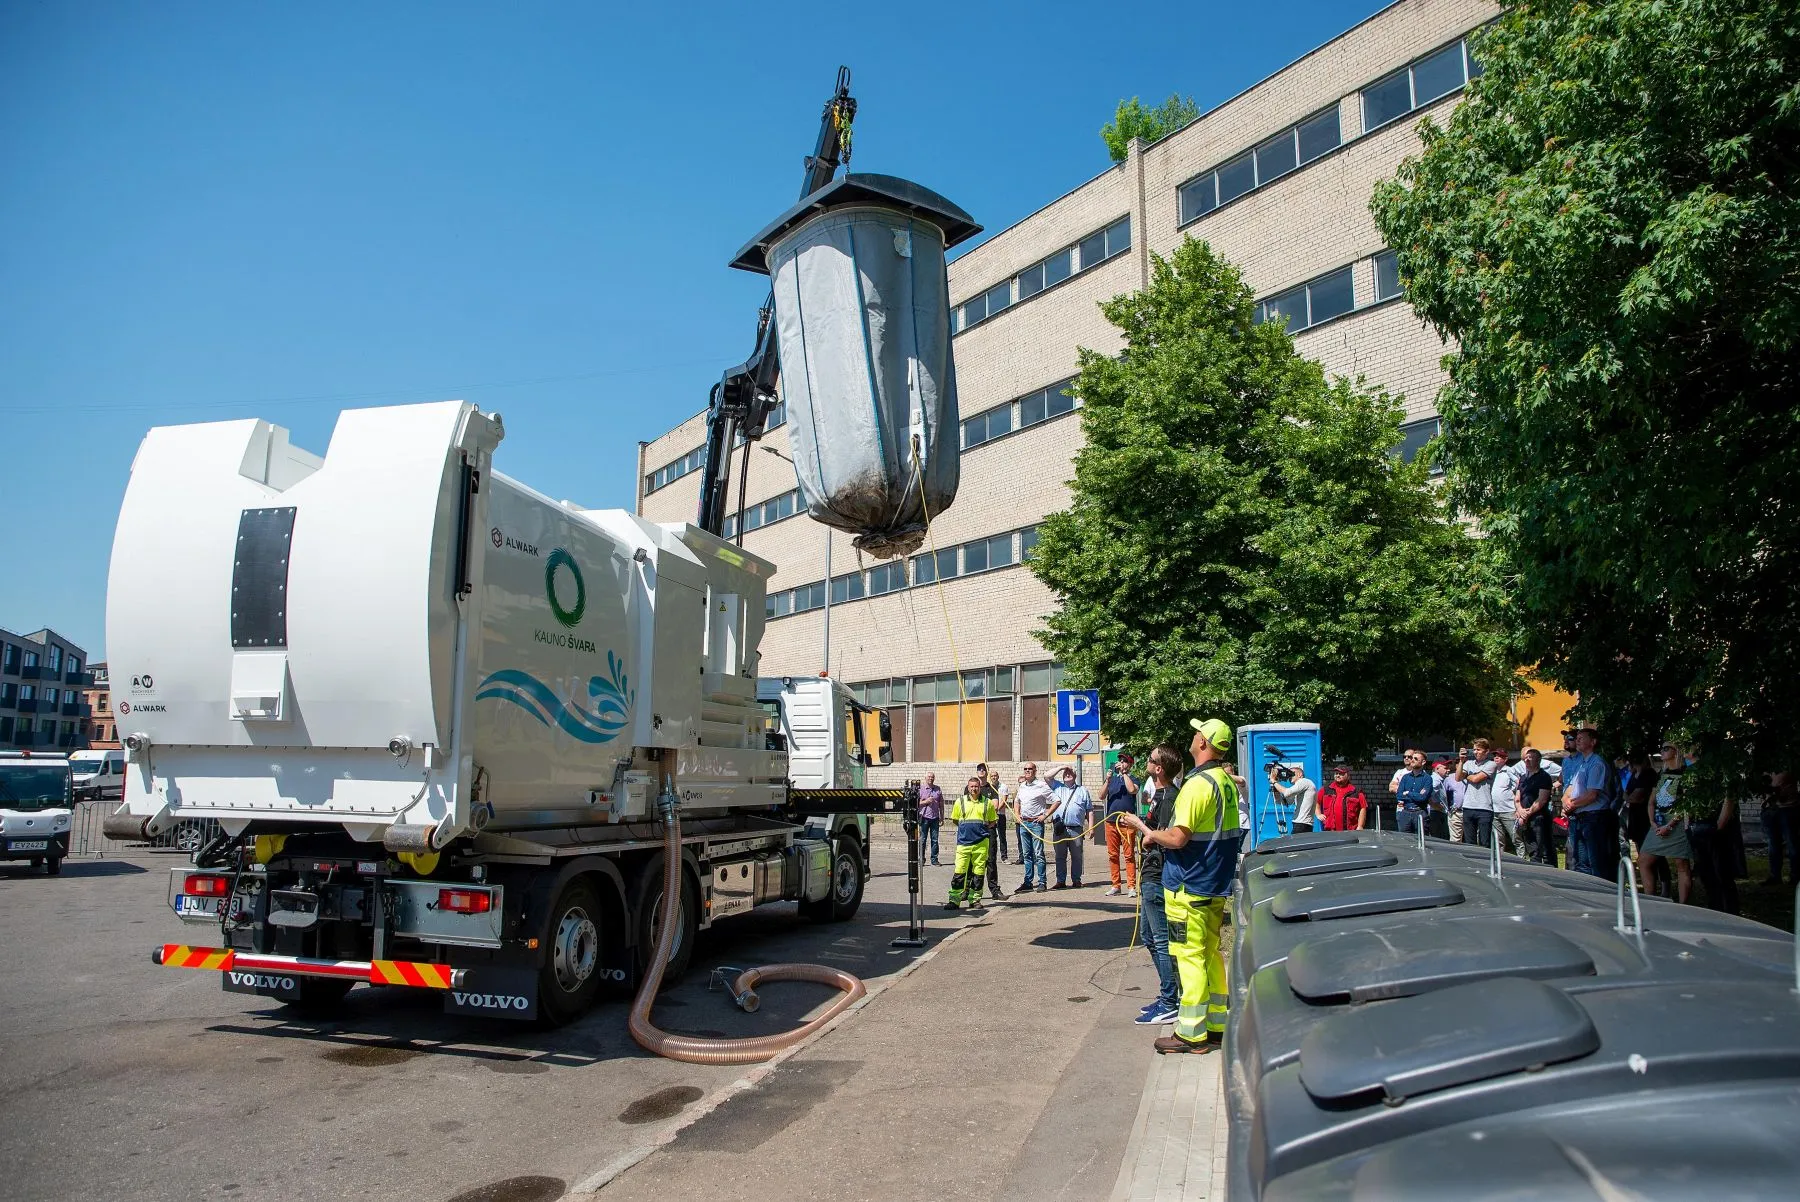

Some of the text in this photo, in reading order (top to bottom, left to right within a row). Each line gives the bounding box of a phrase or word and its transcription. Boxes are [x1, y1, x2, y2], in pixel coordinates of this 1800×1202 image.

[506, 537, 539, 557] ALWARK
[534, 629, 596, 653] KAUNO ŠVARA
[1069, 695, 1091, 727] P
[184, 898, 238, 913] LJV 63
[229, 971, 295, 990] VOLVO
[452, 991, 529, 1010] VOLVO
